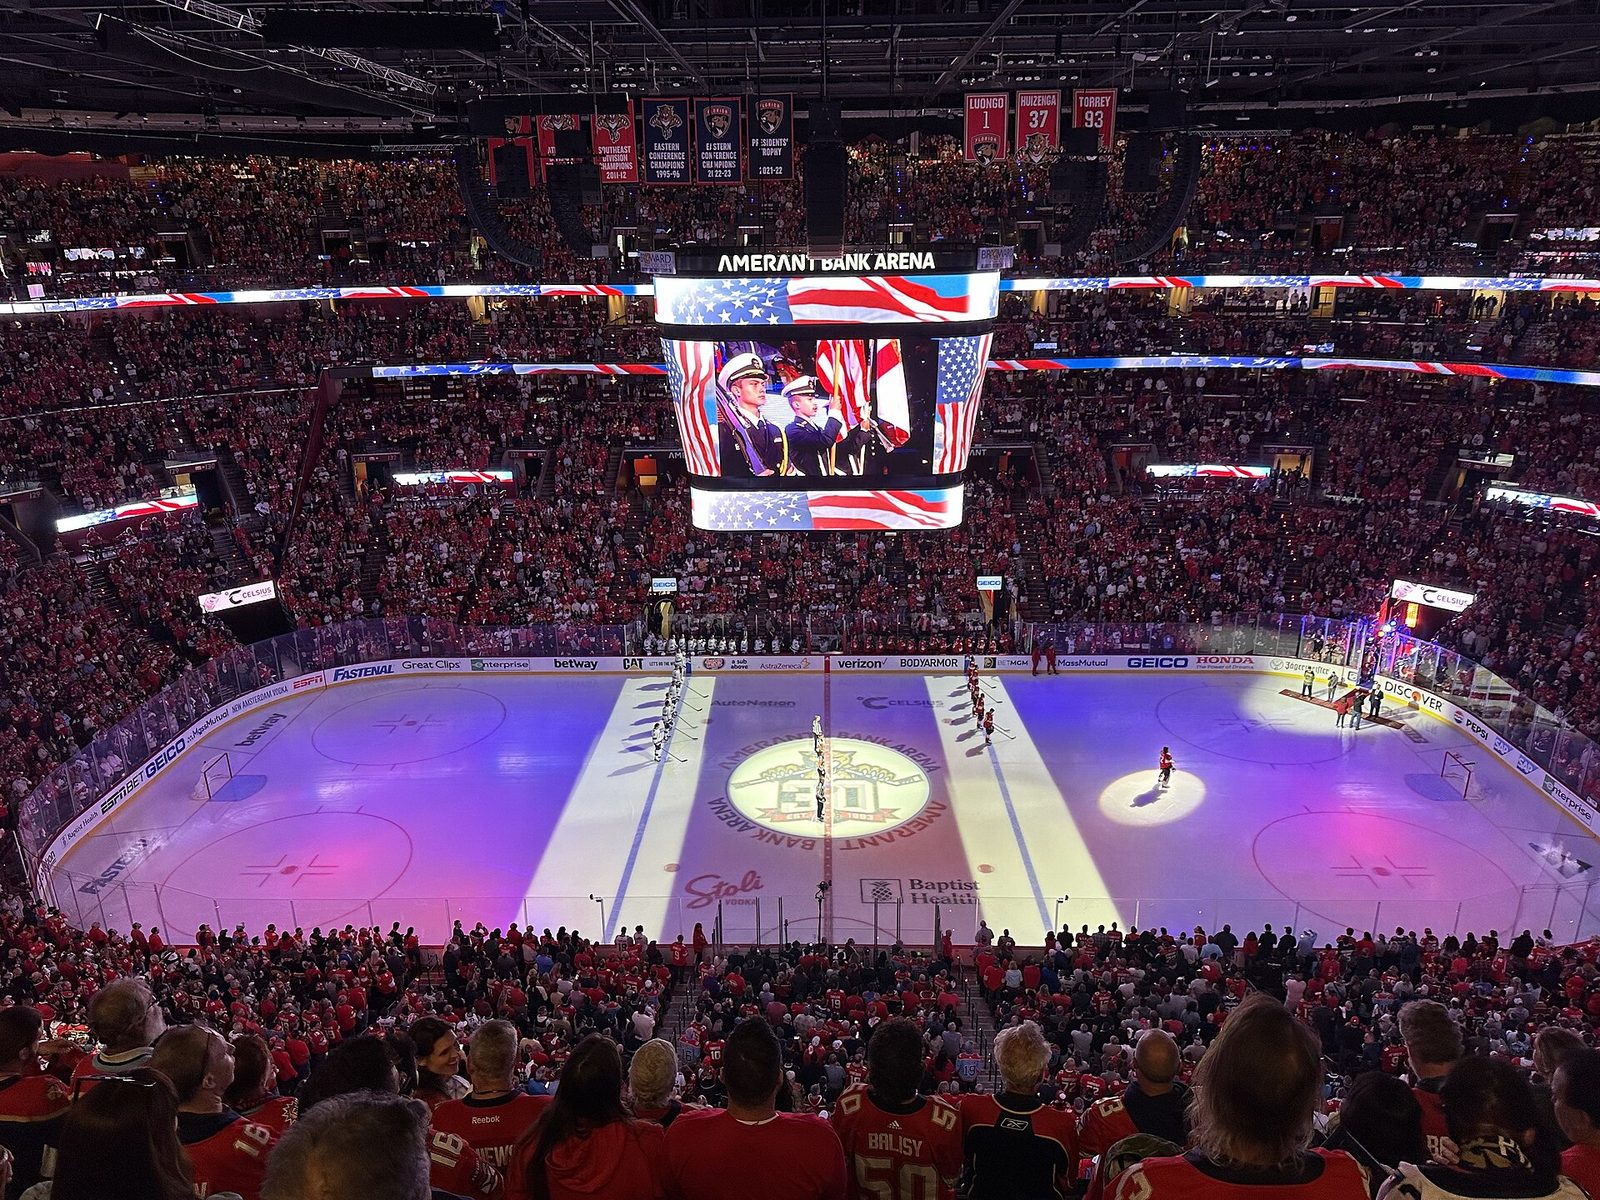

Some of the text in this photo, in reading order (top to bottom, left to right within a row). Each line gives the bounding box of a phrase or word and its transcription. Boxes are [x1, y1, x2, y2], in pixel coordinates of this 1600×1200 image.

[969, 98, 1004, 110] LUONGO
[1020, 95, 1057, 107] HUIZENGA
[1079, 96, 1111, 108] TORREY
[982, 111, 990, 129] 1
[1029, 110, 1048, 129] 37
[1084, 110, 1104, 128] 93
[598, 146, 631, 154] SOUTHEAST
[653, 142, 680, 151] EASTERN
[649, 152, 685, 160] CONFERENCE
[650, 161, 685, 169] CHAMPIONS
[606, 171, 627, 179] 2011-12
[656, 170, 680, 179] 1995-96
[718, 252, 936, 272] AMERANT BANK ARENA
[242, 587, 272, 599] CELSIUS
[1436, 594, 1468, 606] CELSIUS
[401, 660, 460, 671] Great Clips
[554, 658, 598, 671] betway
[623, 658, 644, 670] CAT
[838, 659, 882, 669] verizon
[900, 658, 958, 668] BODYARMOR
[1057, 659, 1108, 667] MassMutual
[1127, 657, 1188, 669] GEICO
[1196, 656, 1254, 664] HONDA
[332, 664, 395, 682] FASTENAL
[292, 675, 323, 690] ESPN
[231, 686, 288, 713] NEW AMSTERDAM VODKA
[711, 700, 796, 708] AutoNation
[888, 699, 944, 707] CELSIUS
[1384, 681, 1443, 712] DISCOVER
[193, 709, 229, 736] MassMutual
[234, 713, 287, 747] betway
[1465, 719, 1489, 741] PEPSI
[838, 731, 892, 746] BANK
[891, 744, 942, 773] ARENA
[1494, 739, 1509, 754] SAP
[145, 738, 186, 778] GEICO
[1517, 757, 1533, 774] SAP
[100, 770, 145, 815] ESPN BET
[1545, 782, 1592, 821] enterprise
[708, 797, 947, 851] AMERANT BANK ARENA
[683, 869, 765, 910] Stoli
[909, 878, 980, 893] Baptist
[831, 999, 841, 1009] 19
[471, 1115, 500, 1125] Reebok
[931, 1104, 957, 1131] 5
[233, 1124, 270, 1158] 16
[868, 1132, 922, 1157] BALISY
[430, 1131, 463, 1168] 16
[855, 1153, 937, 1200] 50
